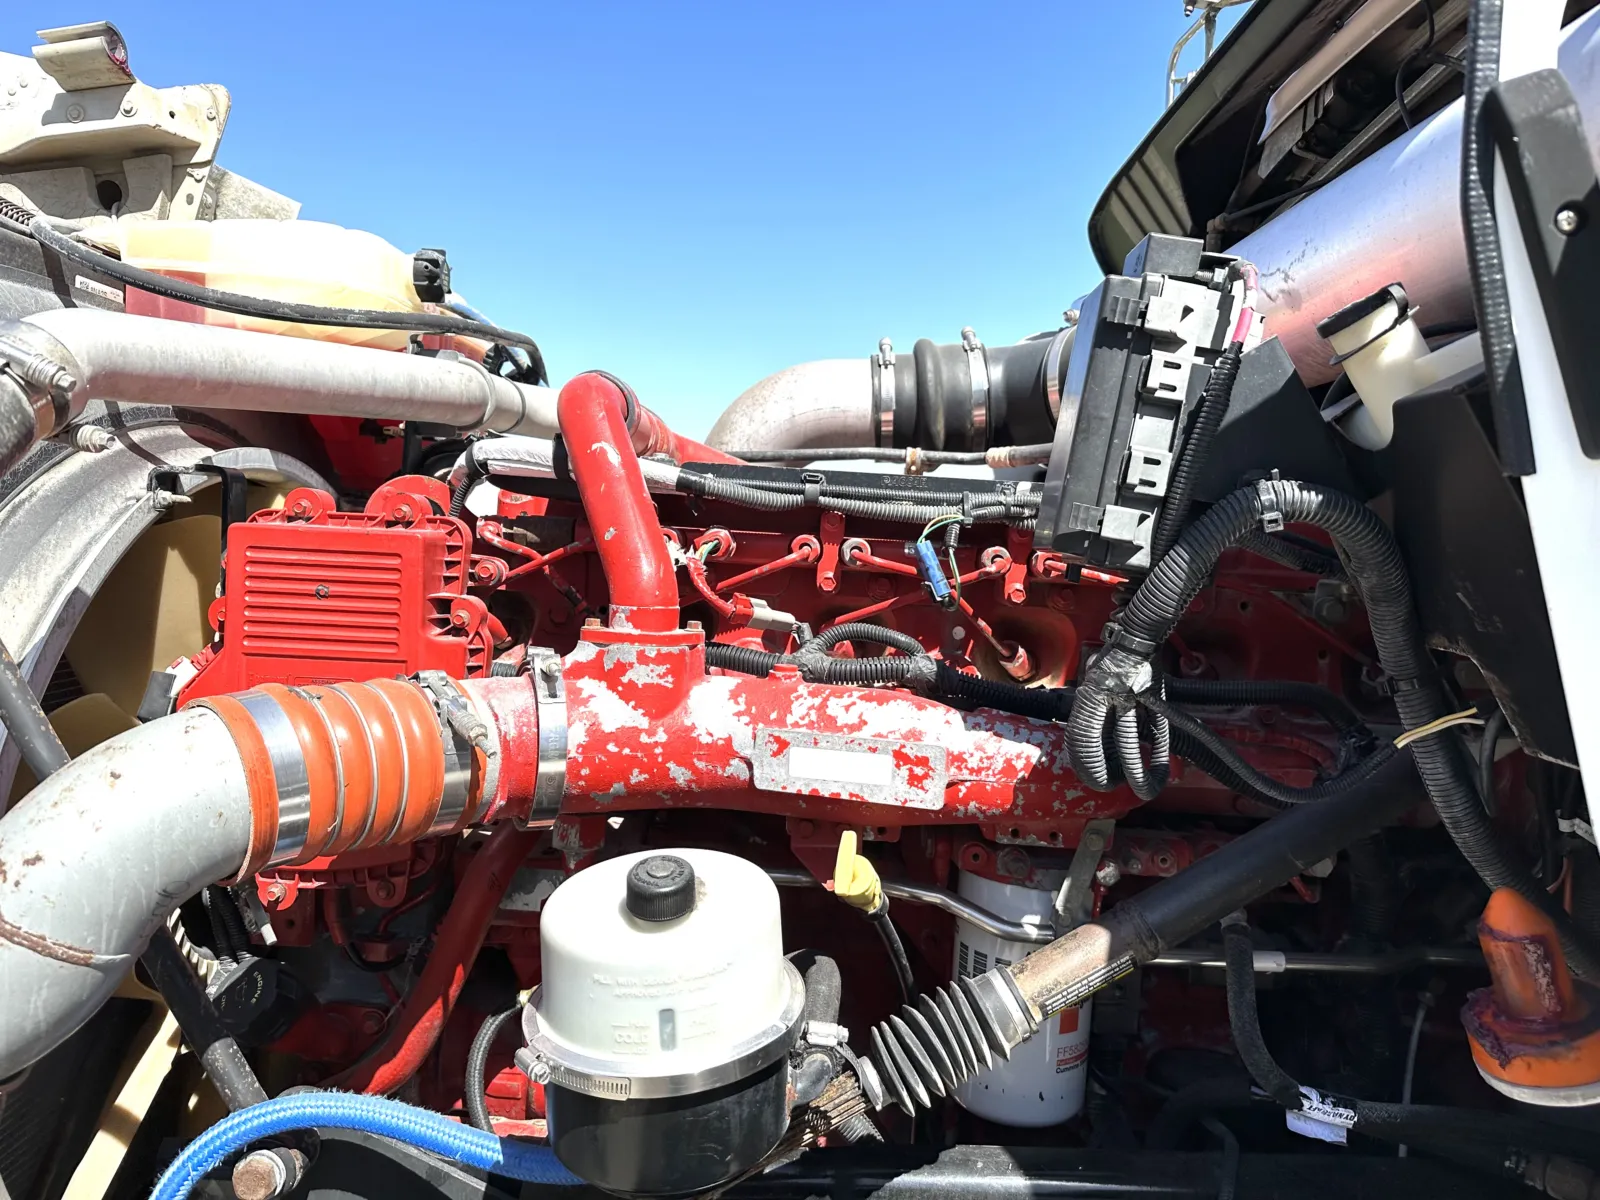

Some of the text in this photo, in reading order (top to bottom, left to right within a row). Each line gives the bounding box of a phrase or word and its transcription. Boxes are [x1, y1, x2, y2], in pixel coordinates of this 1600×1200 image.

[166, 289, 196, 301] GALAXY
[251, 971, 262, 1003] ENGINE
[614, 1031, 649, 1045] COLD
[1306, 1105, 1355, 1121] DYNACRAFT
